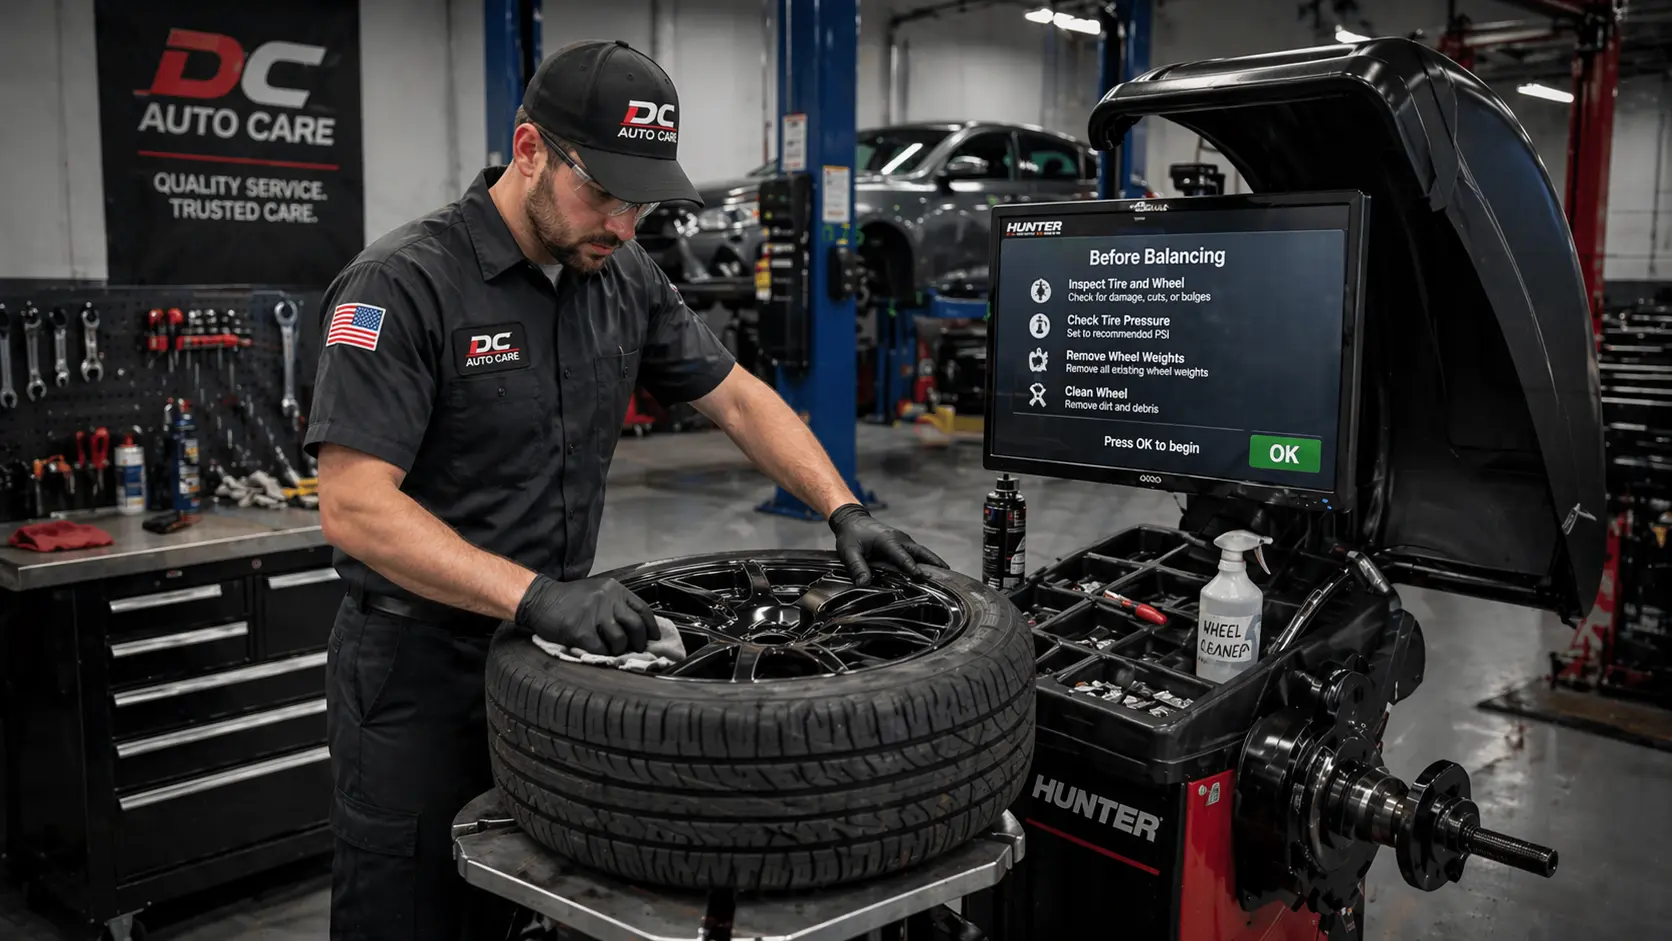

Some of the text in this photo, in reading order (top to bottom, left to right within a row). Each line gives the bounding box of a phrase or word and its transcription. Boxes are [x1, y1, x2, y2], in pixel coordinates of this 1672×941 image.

[134, 28, 327, 109] DC
[623, 100, 675, 128] DC
[138, 102, 336, 146] AUTO CARE
[617, 127, 655, 140] AUTO
[153, 172, 328, 201] QUALITY SERVICE.
[169, 198, 318, 224] TRUSTED CARE.
[1006, 221, 1063, 233] HUNTER
[1089, 247, 1226, 267] Before Balancing
[1068, 276, 1185, 292] Inspect Tire and Wheel
[1067, 292, 1094, 302] Check
[1095, 292, 1107, 302] for
[1108, 292, 1146, 304] damage,
[1147, 293, 1168, 303] cuts,
[1170, 293, 1180, 302] or
[1067, 314, 1171, 327] Check Tire Pressure
[470, 332, 512, 353] DC
[1066, 329, 1081, 338] Set
[1082, 329, 1091, 338] to
[1154, 329, 1170, 340] PSI
[466, 352, 520, 367] AUTO CARE
[1066, 350, 1185, 366] Remove Wheel Weights
[1065, 363, 1099, 374] Remove
[1100, 364, 1111, 374] all
[1146, 366, 1173, 376] wheel
[1174, 367, 1209, 379] weights
[1065, 385, 1128, 399] Clean Wheel
[1064, 399, 1159, 414] Remove dirt and debris
[1104, 435, 1200, 456] Press OK to begin
[1269, 444, 1300, 464] OK
[1203, 620, 1241, 638] WHEEL
[1032, 773, 1161, 843] HUNTER
